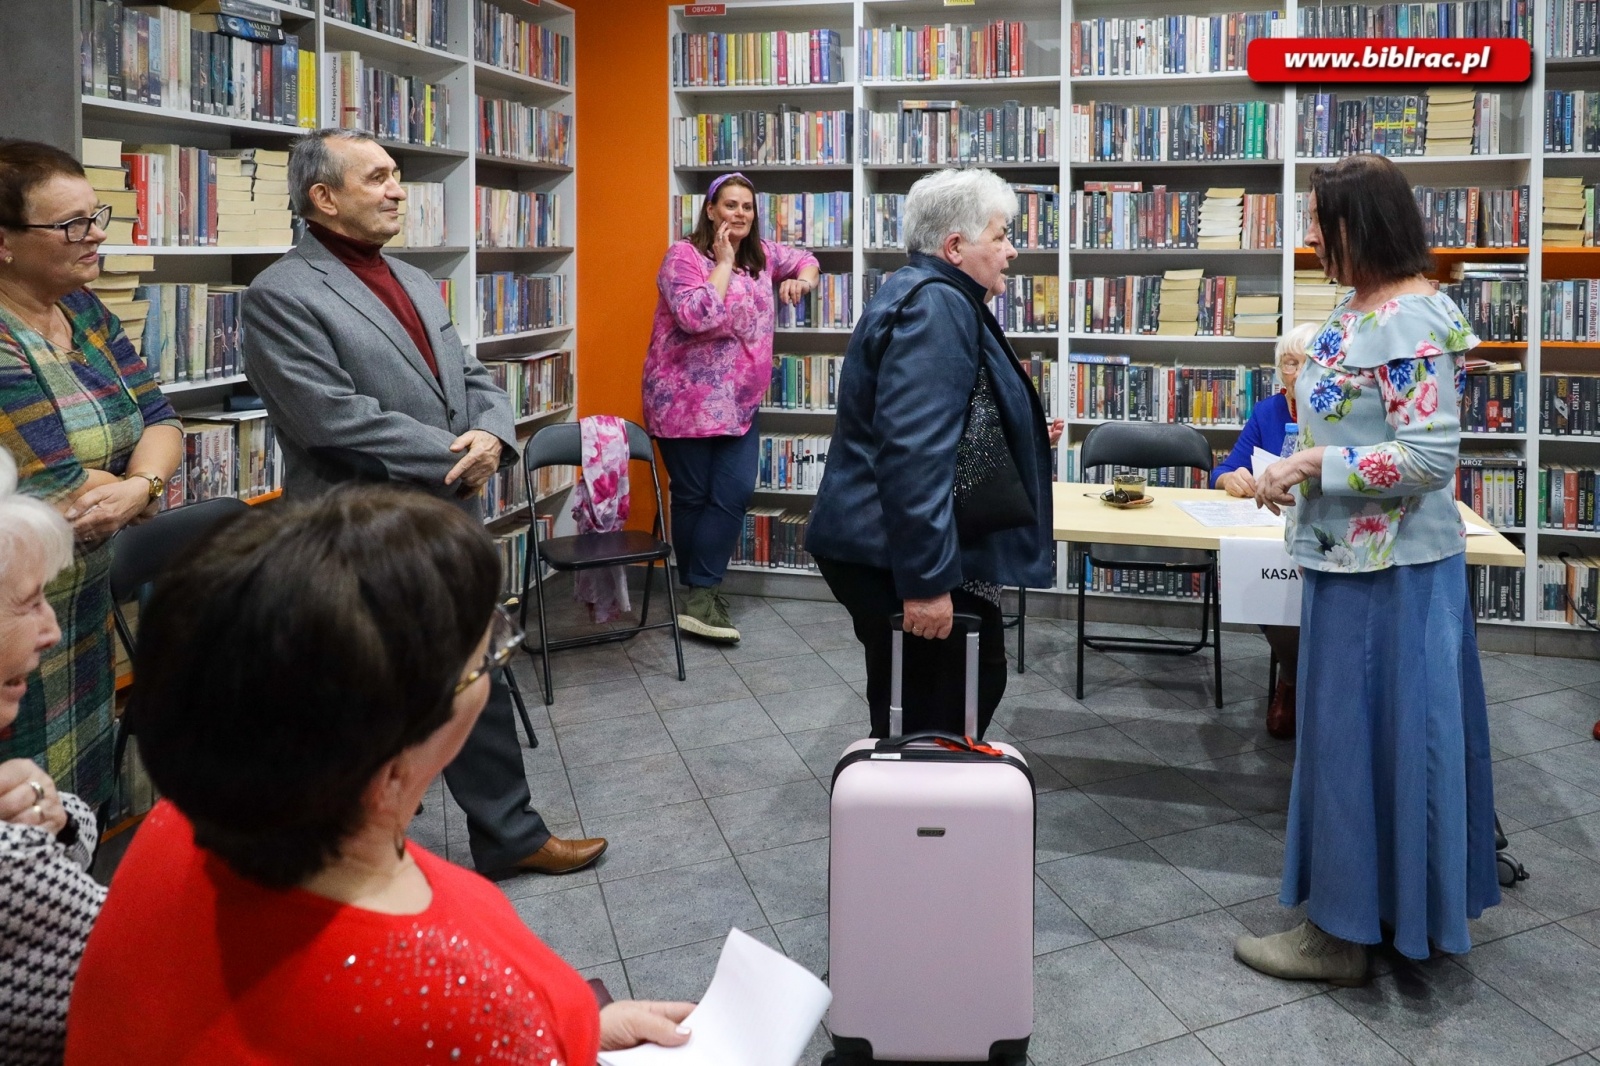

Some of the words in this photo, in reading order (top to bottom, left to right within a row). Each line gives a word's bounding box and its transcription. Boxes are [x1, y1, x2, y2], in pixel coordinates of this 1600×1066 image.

[1572, 382, 1580, 411] CHRISTINE
[1554, 476, 1562, 498] KOONTZ
[1261, 568, 1299, 581] KASA
